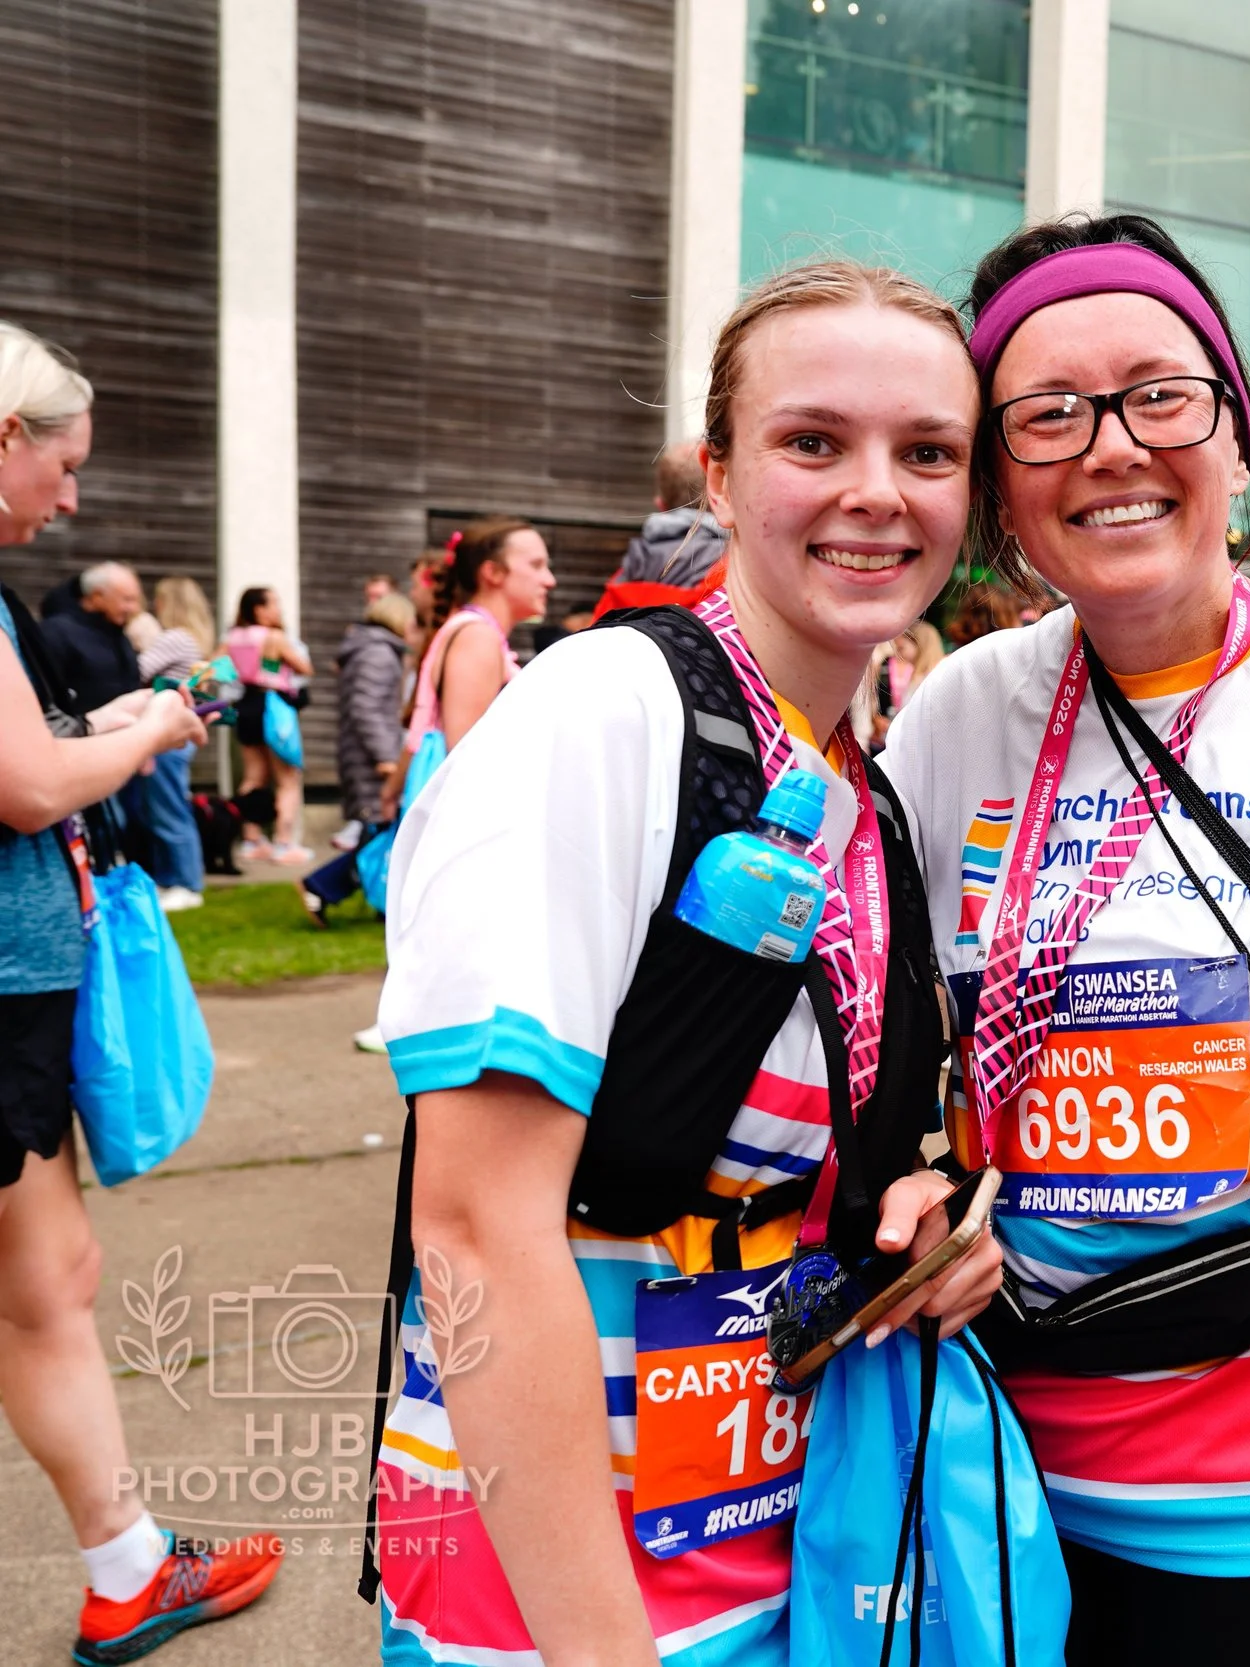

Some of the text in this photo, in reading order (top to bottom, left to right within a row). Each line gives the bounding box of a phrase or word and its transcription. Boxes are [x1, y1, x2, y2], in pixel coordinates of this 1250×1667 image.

[1052, 684, 1076, 736] 2026
[1026, 778, 1043, 825] EVENTS LTD
[1022, 779, 1054, 873] FRONTRUNNER
[852, 858, 865, 905] EVENTS LTD
[864, 855, 884, 956] FRONTRUNNER
[1074, 969, 1177, 996] SWANSEA
[1074, 991, 1179, 1015] Half Marathon
[1100, 1013, 1137, 1023] MARATHON
[1139, 1011, 1178, 1021] ABERTAWE
[1139, 1057, 1247, 1077] RESEARCH WALES
[1193, 1038, 1246, 1055] CANCER
[1017, 1083, 1191, 1161] 6936
[1019, 1186, 1188, 1214] #RUNSWANSEA
[645, 1352, 777, 1404] CARYS
